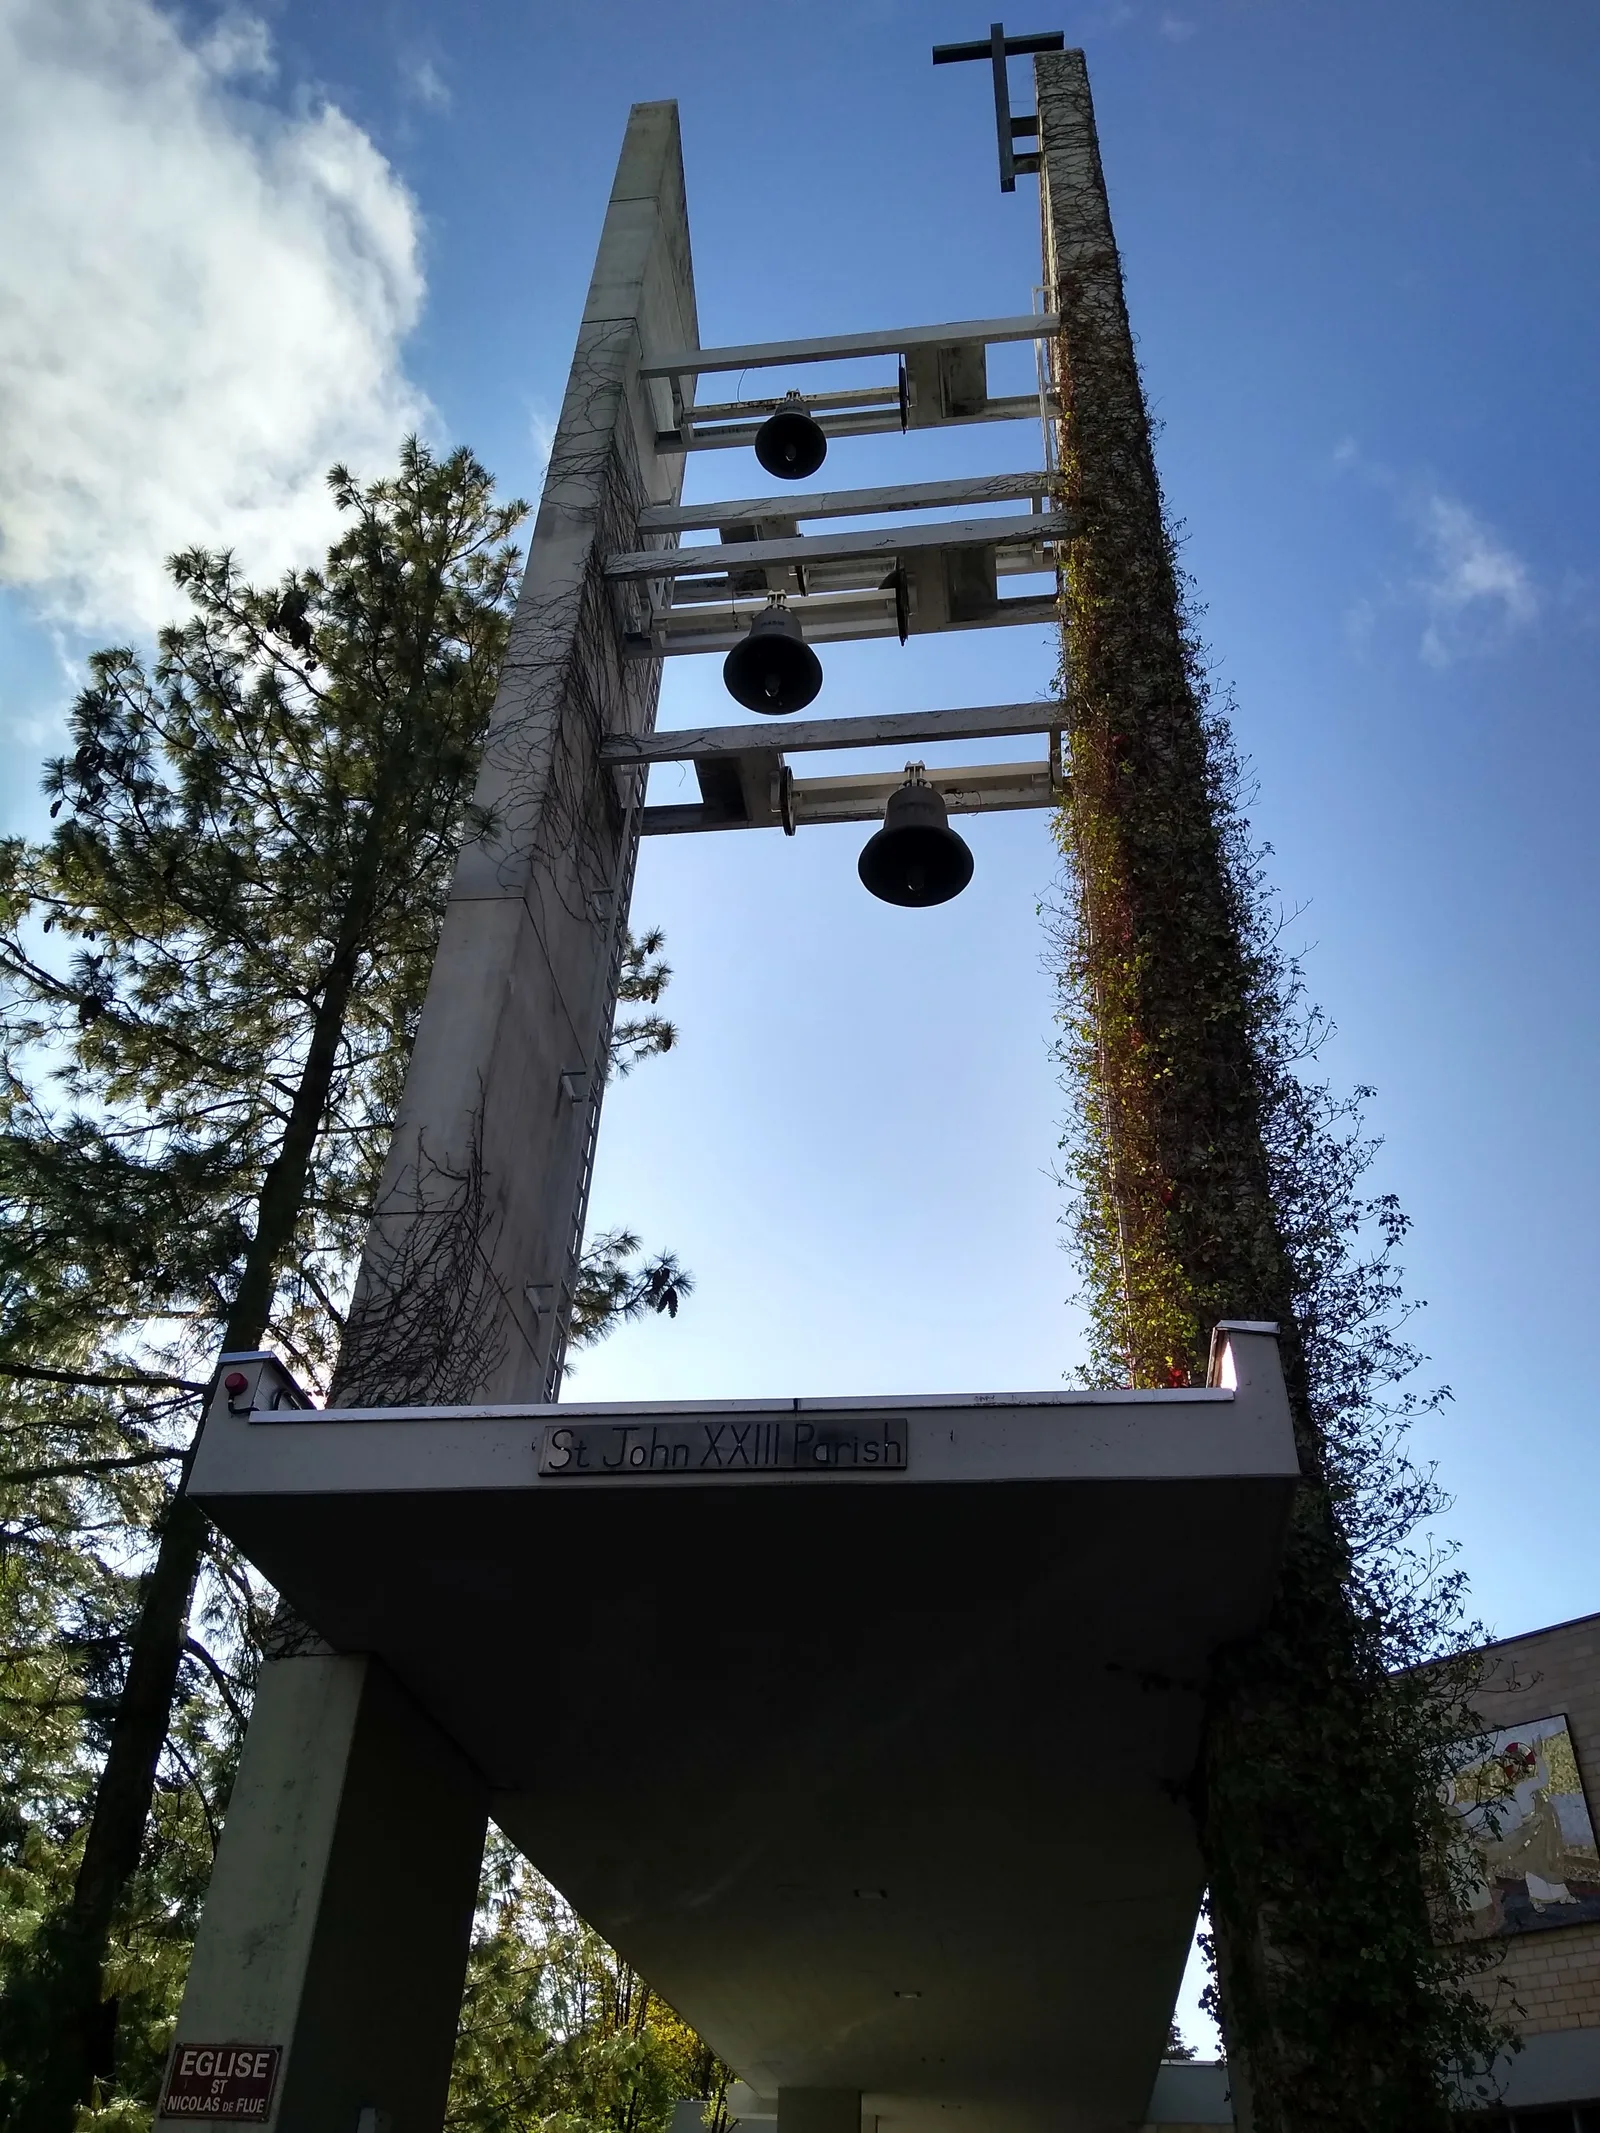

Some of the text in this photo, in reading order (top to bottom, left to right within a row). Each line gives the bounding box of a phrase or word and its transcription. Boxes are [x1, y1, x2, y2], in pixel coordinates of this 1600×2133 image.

[548, 1421, 902, 1470] St John XXIII Parish
[179, 2050, 270, 2078] EGLISE
[211, 2079, 228, 2094] ST
[167, 2095, 266, 2113] NICOLAS DE FLUE
